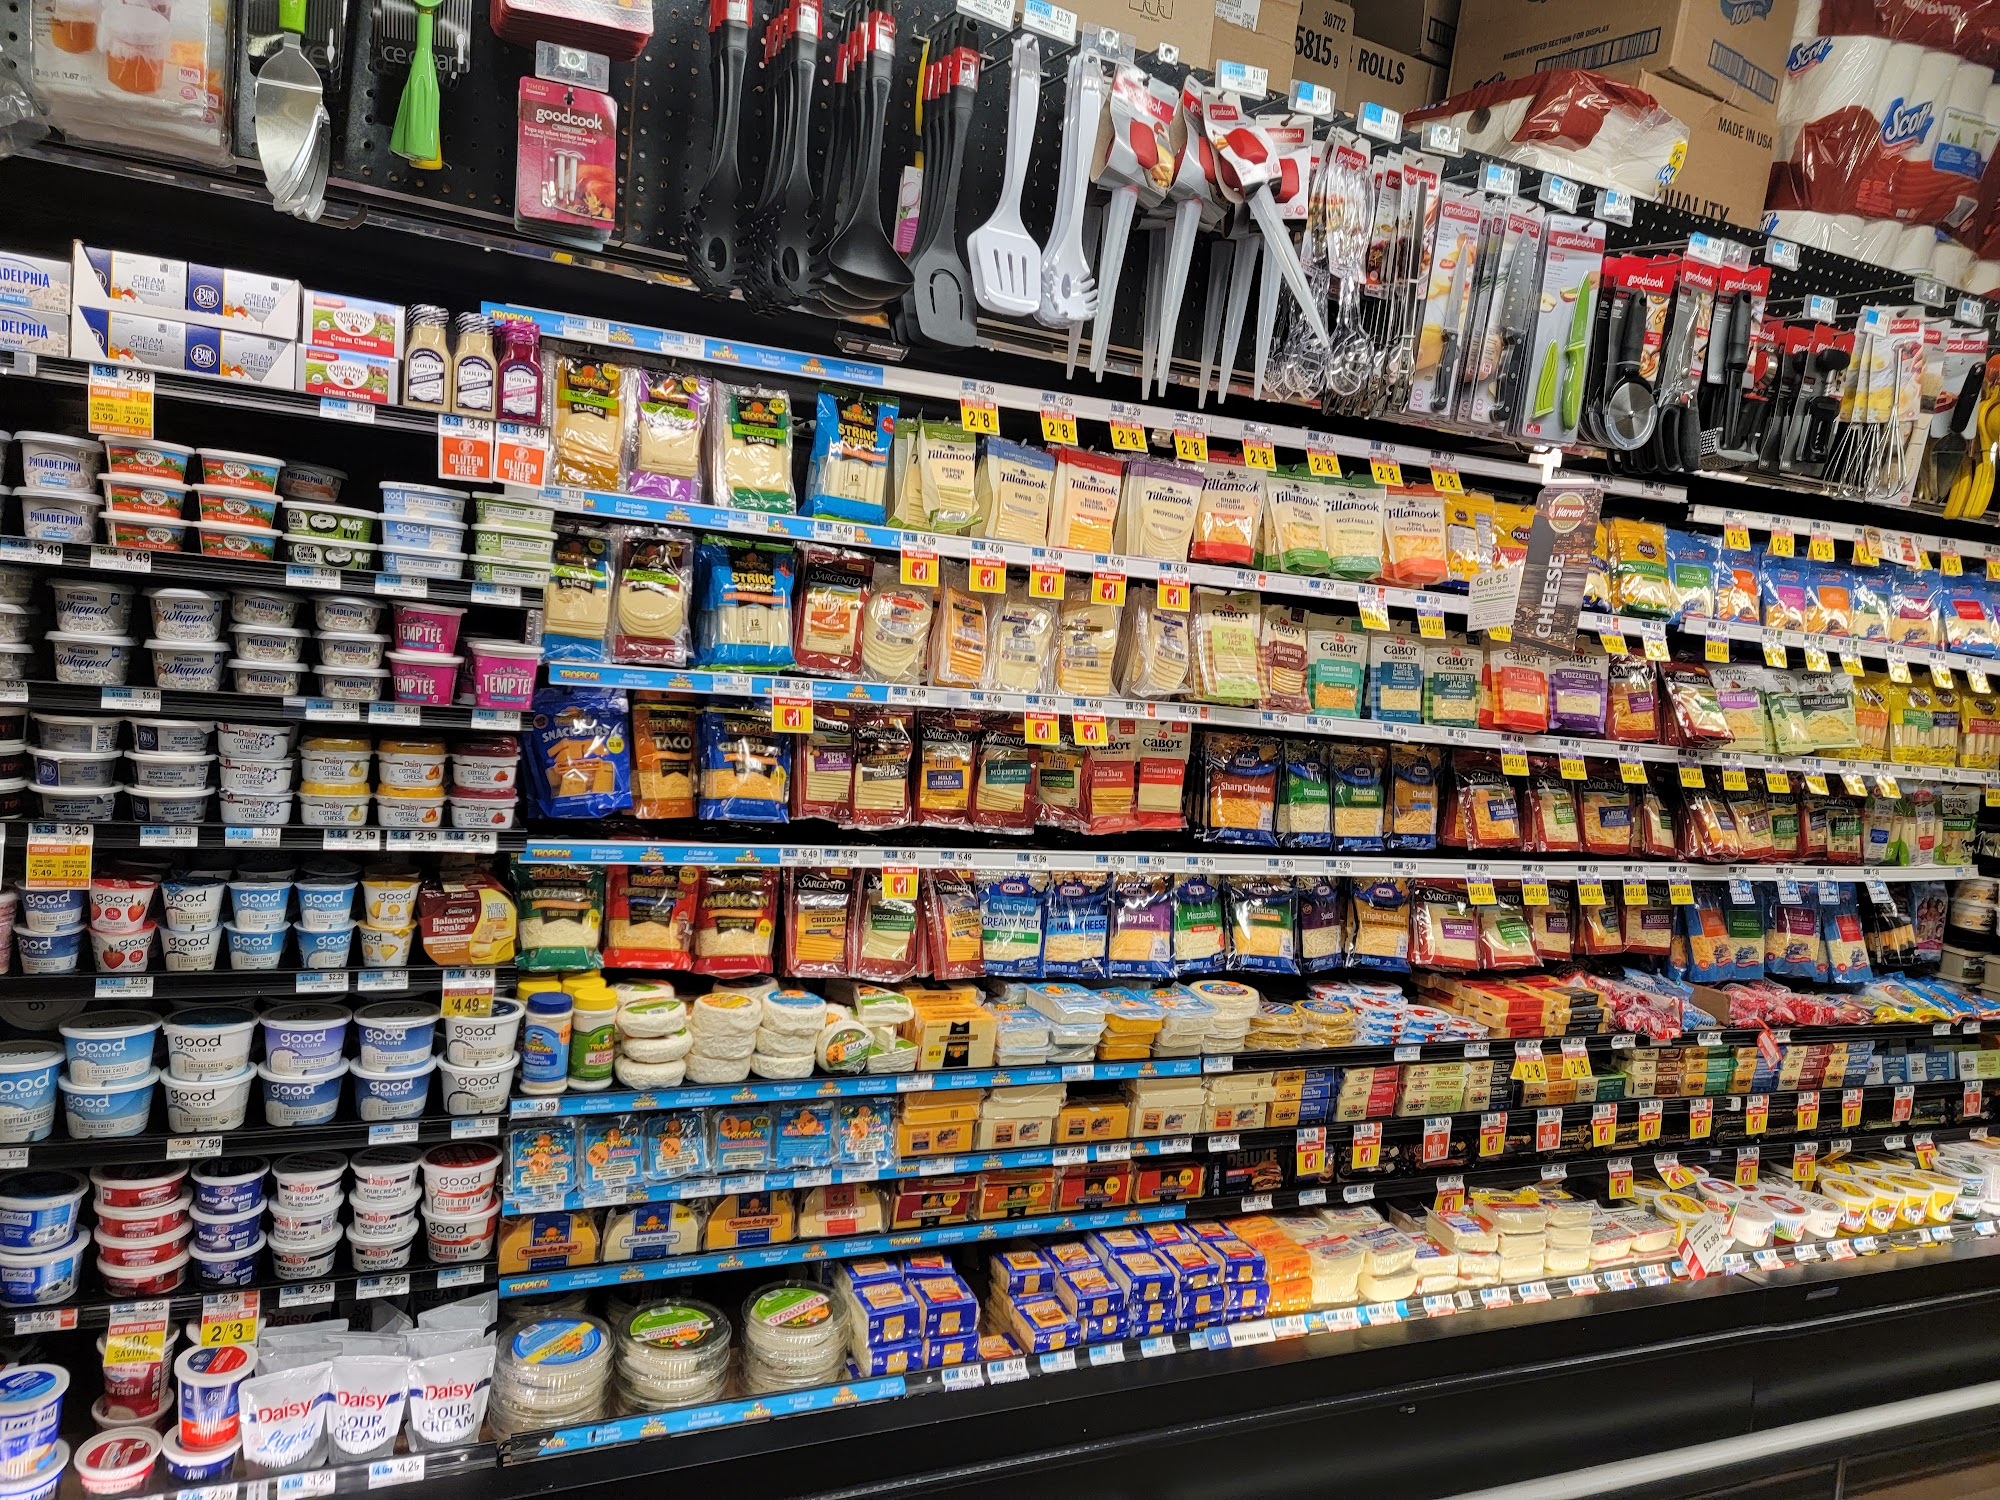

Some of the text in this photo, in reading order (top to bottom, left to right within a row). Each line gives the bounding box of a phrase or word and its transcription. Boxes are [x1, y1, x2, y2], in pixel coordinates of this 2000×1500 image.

[1323, 10, 1346, 32] 30772
[1296, 27, 1338, 69] 5815 9
[1503, 50, 1525, 61] REMOVE
[1548, 36, 1571, 47] SECTION
[1573, 32, 1584, 41] FOR
[1585, 24, 1610, 38] DISPLAY
[381, 39, 406, 64] ice
[1792, 38, 1831, 70] Scott
[180, 68, 199, 79] 100%
[1357, 48, 1406, 86] ROLLS
[526, 83, 549, 91] TIMERS
[536, 108, 602, 131] goodcook
[1885, 102, 1932, 140] Scott
[560, 133, 576, 141] turkey
[583, 137, 596, 145] ready
[1718, 117, 1772, 151] MADE IN USA
[133, 274, 165, 286] CREAM
[1627, 273, 1665, 289] goodcook
[1685, 270, 1713, 288] goodcook
[131, 281, 167, 292] CHEESE
[336, 311, 375, 324] ORGANIC
[129, 341, 165, 352] CHEESE
[130, 334, 165, 347] CREAM
[330, 333, 378, 348] Cream Cheese
[464, 370, 487, 378] GOLD'S
[509, 376, 532, 384] GOLD'S
[92, 388, 110, 396] SMART
[323, 387, 371, 400] Cream Cheese
[573, 404, 604, 417] SLICES
[969, 410, 990, 429] 2/$8
[523, 426, 545, 439] $3.49
[838, 423, 878, 442] STRING
[1048, 421, 1069, 439] 2/$8
[747, 436, 775, 445] SLICES
[1118, 429, 1138, 446] 2/$8
[28, 456, 81, 472] PHILADELPHIA
[449, 454, 483, 467] GLUTEN
[1314, 457, 1333, 473] 2/$8
[455, 465, 478, 476] FREE
[503, 461, 537, 474] GLUTEN
[508, 472, 532, 483] FREE
[851, 474, 859, 482] 12
[999, 471, 1048, 490] Tillamook
[1438, 474, 1456, 489] 2/$8
[1070, 477, 1118, 496] Tillamook
[1201, 478, 1261, 494] Tillamook
[1145, 489, 1193, 507] Tillamook
[1220, 497, 1241, 505] SHARP
[30, 512, 83, 526] PHILADELPHIA
[1153, 508, 1185, 521] PROVOLONE
[1384, 508, 1441, 520] Tillamook
[1556, 507, 1585, 518] Harvest
[34, 542, 62, 556] $9.49
[123, 551, 150, 563] $6.49
[731, 572, 776, 586] STRING
[810, 570, 860, 586] SARGENTO
[1476, 576, 1493, 587] Get
[1536, 554, 1566, 638] CHEESE
[58, 601, 112, 617] Whipped
[162, 610, 215, 625] Whipped
[750, 618, 760, 627] 12
[1221, 631, 1247, 642] PEPPER
[57, 654, 112, 669] Whipped
[560, 670, 600, 681] TROPICAL
[1320, 663, 1353, 676] Vermont Sharp
[1561, 670, 1599, 682] MOZZARELLA
[1438, 673, 1475, 682] MONTEREY
[1510, 671, 1542, 683] MEXICAN
[1448, 680, 1467, 689] JACK
[923, 728, 970, 743] SARGENTO
[652, 736, 691, 749] TACO
[1238, 758, 1255, 766] Kraft
[990, 768, 1027, 776] MUENSTER
[1143, 766, 1182, 775] Seriously Sharp
[938, 774, 953, 782] MILD
[1220, 782, 1271, 794] Sharp Cheddar
[1352, 787, 1376, 796] Mexican
[352, 831, 375, 841] $2.19
[532, 849, 572, 858] TROPICAL
[26, 891, 71, 909] good
[96, 893, 134, 907] good
[702, 894, 769, 908] MEXICAN
[486, 903, 508, 913] WHEAT
[487, 909, 507, 918] THINS
[1187, 909, 1217, 920] Mozzarella
[432, 915, 475, 926] Balanced
[811, 915, 846, 924] CHEDDAR
[872, 913, 915, 923] MOZZARELLA
[981, 915, 1039, 929] CREAMY MELT
[1361, 911, 1407, 923] Triple Cheddar
[432, 923, 466, 933] Breaks
[1445, 923, 1473, 931] MONTEREY
[469, 970, 491, 979] $4.99
[451, 998, 480, 1013] $4.49
[175, 1035, 222, 1052] good
[280, 1030, 327, 1048] good
[535, 1101, 556, 1112] $3.99
[196, 1138, 221, 1149] $7.99
[1227, 1148, 1278, 1168] DELUXE
[439, 1173, 481, 1189] good
[289, 1183, 317, 1195] Daisy
[201, 1192, 252, 1203] Sour Cream
[437, 1195, 481, 1206] SOUR CREAM
[1704, 1233, 1719, 1252] $3.99
[510, 1279, 550, 1292] TROPICAL
[862, 1283, 900, 1297] Singles
[211, 1323, 243, 1342] 2/$3
[1212, 1333, 1227, 1346] SALE!
[424, 1384, 476, 1402] Daisy
[337, 1391, 389, 1410] Daisy
[258, 1400, 312, 1424] Daisy
[428, 1404, 471, 1419] SOUR
[338, 1414, 381, 1429] SOUR
[257, 1421, 315, 1452] Light
[334, 1427, 386, 1442] CREAM
